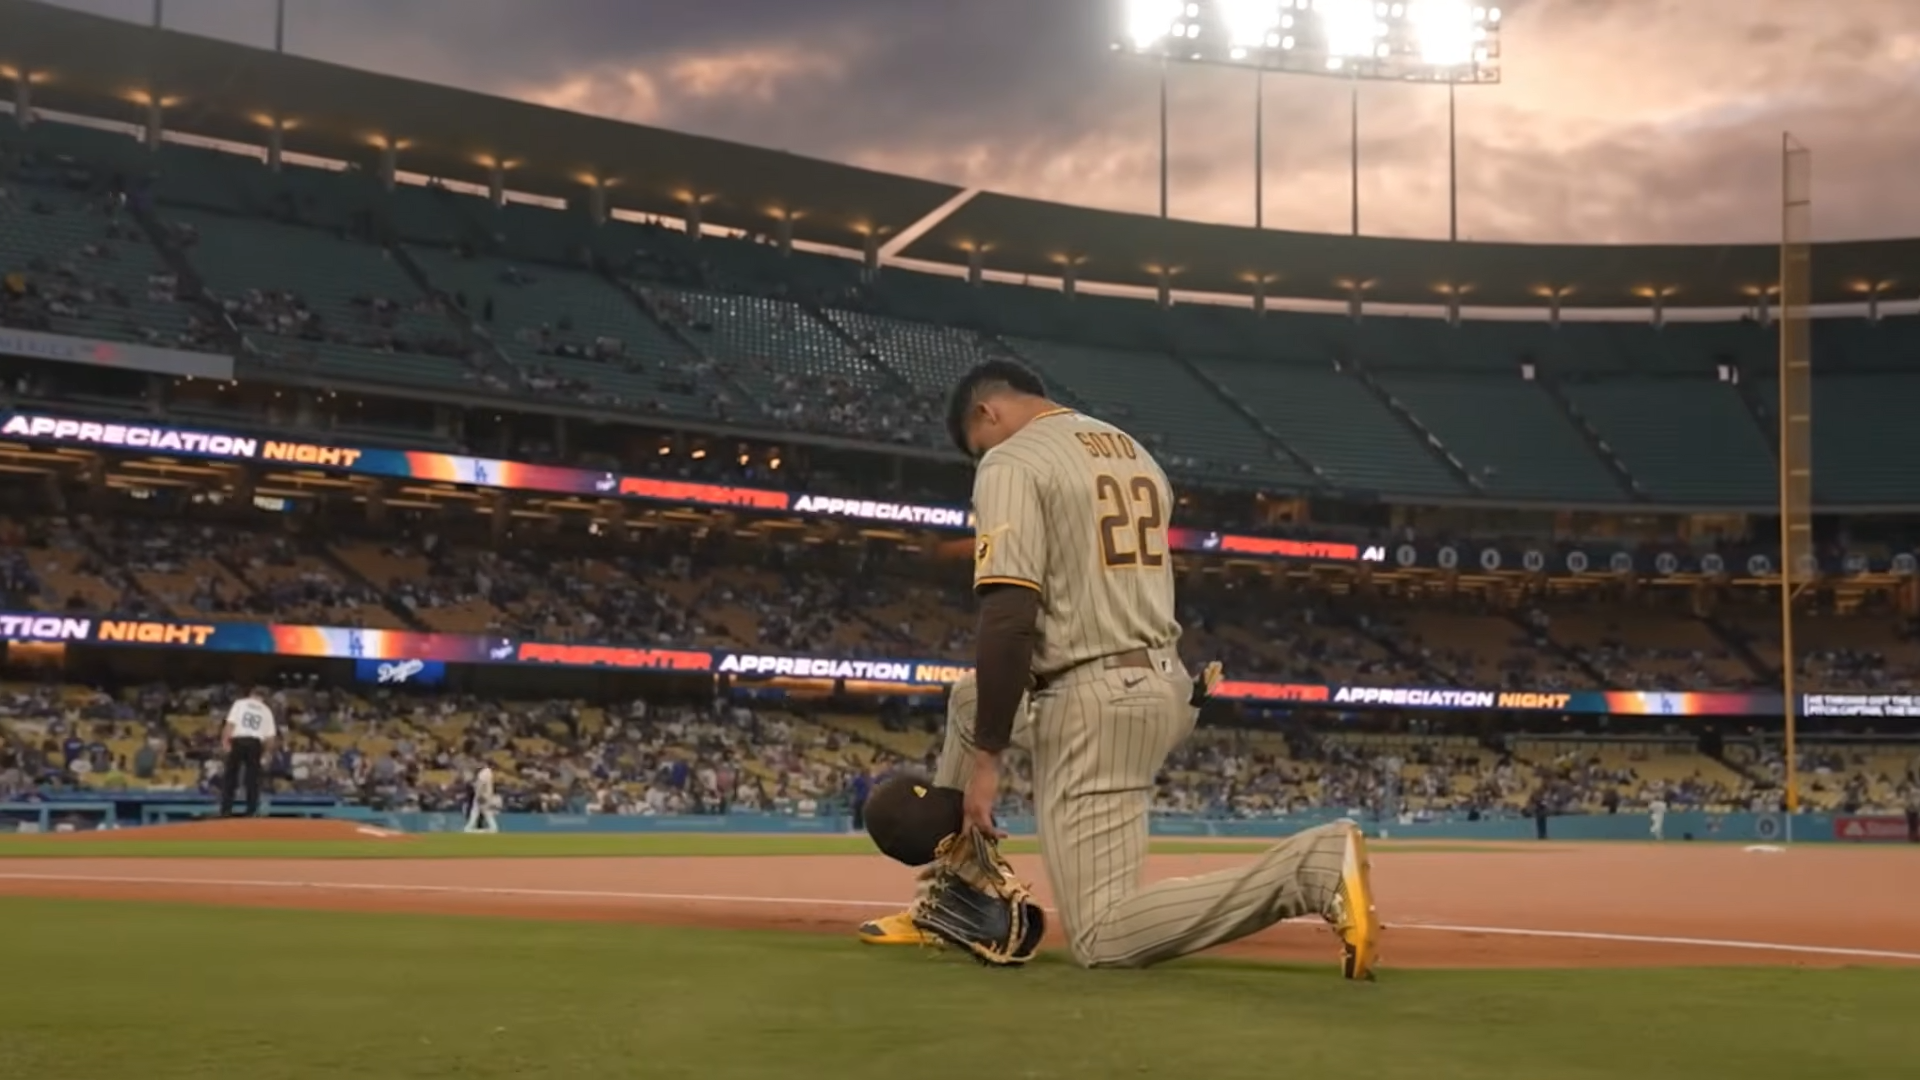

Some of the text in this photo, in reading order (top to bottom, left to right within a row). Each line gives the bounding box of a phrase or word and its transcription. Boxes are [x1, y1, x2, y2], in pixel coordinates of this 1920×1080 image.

[2, 415, 361, 466] APPRECIATION NIGHT
[1074, 432, 1136, 460] SOTO
[794, 495, 963, 526] APPRECIATION
[1095, 471, 1164, 568] 22
[0, 614, 215, 645] TION NIGHT
[719, 654, 910, 681] APPRECIATION
[1334, 686, 1494, 708] APPRECIATION
[1498, 692, 1571, 710] NIGHT
